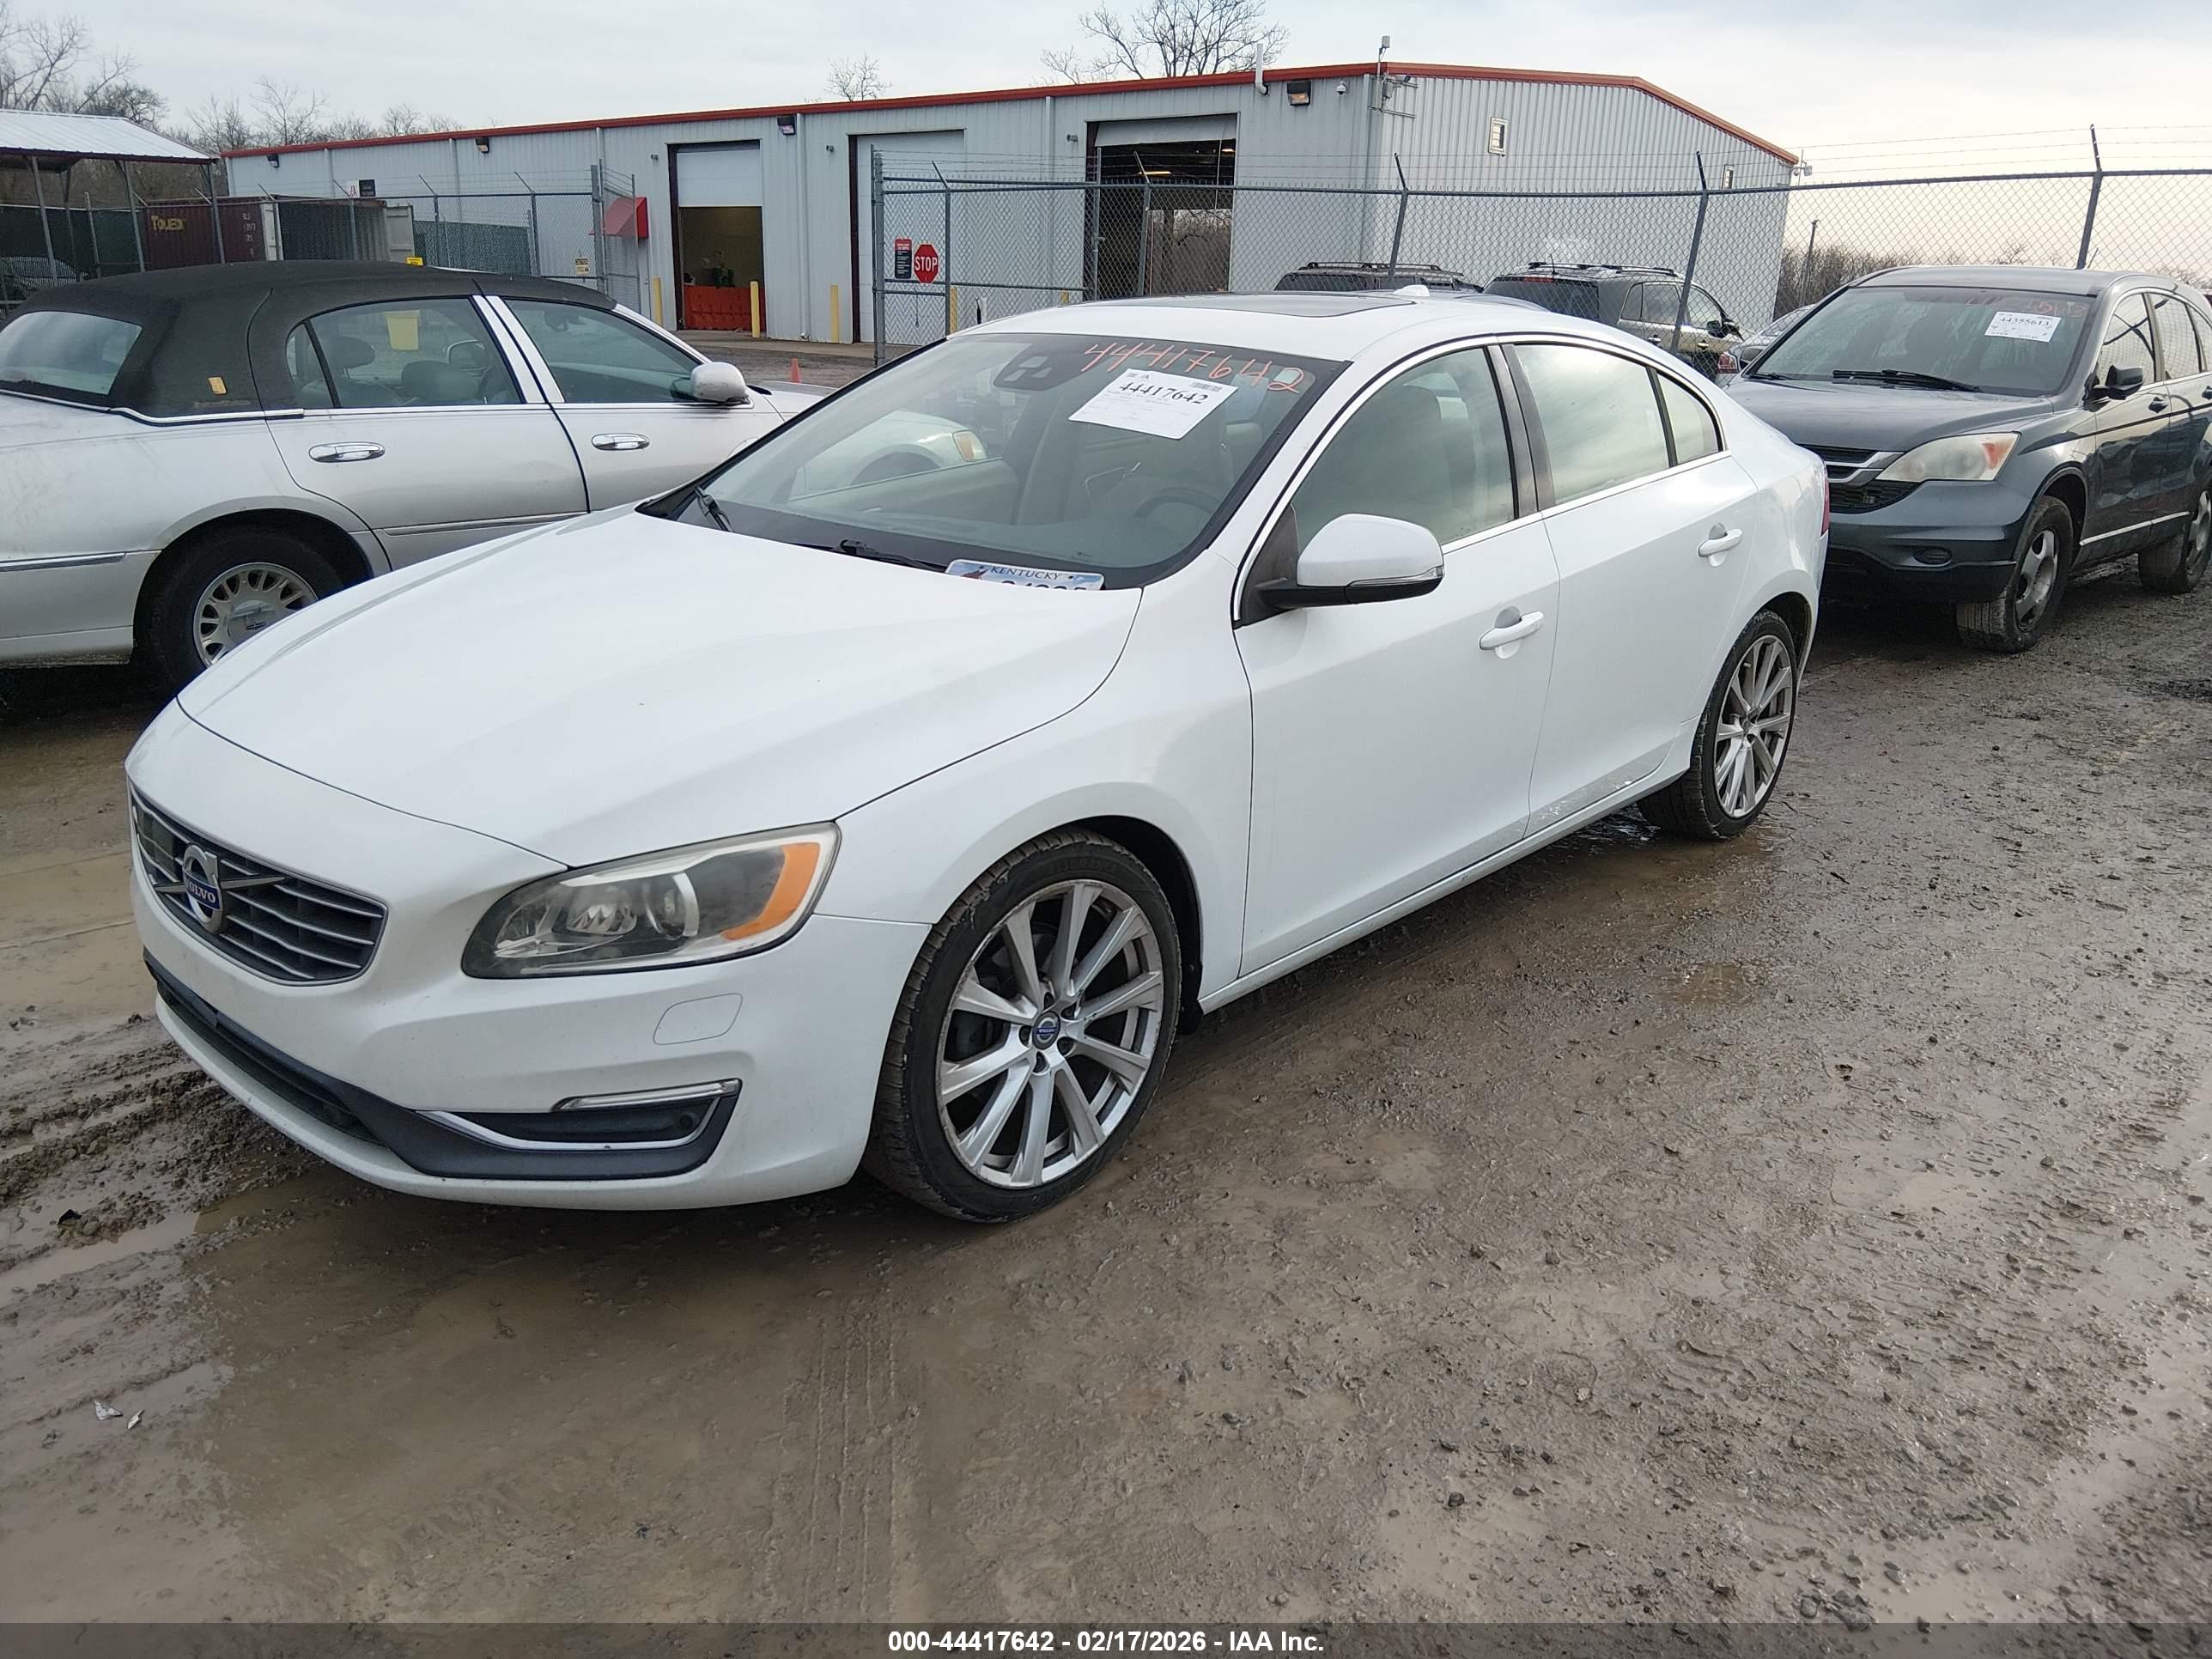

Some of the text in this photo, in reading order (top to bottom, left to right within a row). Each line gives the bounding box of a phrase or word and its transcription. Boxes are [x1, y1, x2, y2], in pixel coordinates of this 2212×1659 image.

[915, 256, 938, 271] STOP
[1081, 342, 1304, 393] 44417642
[1119, 381, 1209, 404] 44417642
[989, 566, 1062, 580] KENTUCKY
[185, 878, 216, 902] VOLVO
